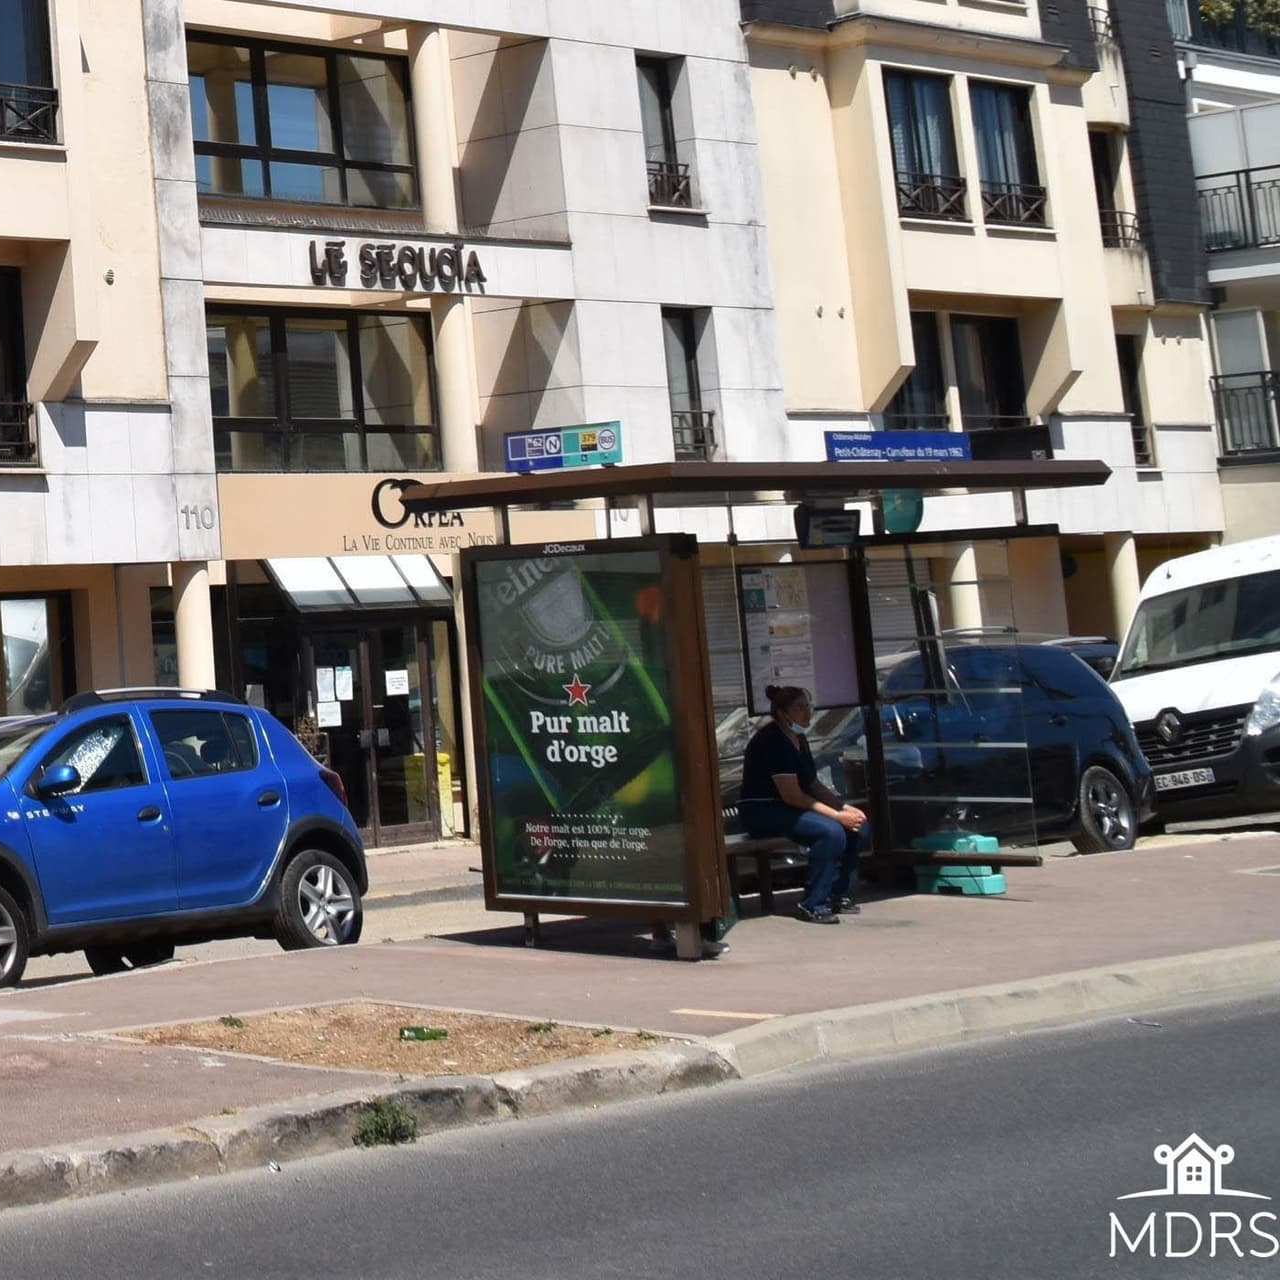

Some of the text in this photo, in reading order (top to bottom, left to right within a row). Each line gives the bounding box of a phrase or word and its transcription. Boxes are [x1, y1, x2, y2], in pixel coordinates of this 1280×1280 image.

[309, 240, 348, 283] LE
[925, 447, 933, 457] 19
[933, 449, 948, 457] mars
[180, 505, 215, 530] 110
[542, 543, 586, 555] JCDecaux
[524, 633, 605, 674] PURE MALT
[529, 709, 631, 734] Pur malt
[546, 739, 618, 768] d'orge
[525, 823, 652, 838] Notre malt est 100% pur orge.
[530, 836, 542, 847] De
[572, 838, 590, 848] rien
[591, 839, 608, 850] que
[609, 838, 621, 849] de
